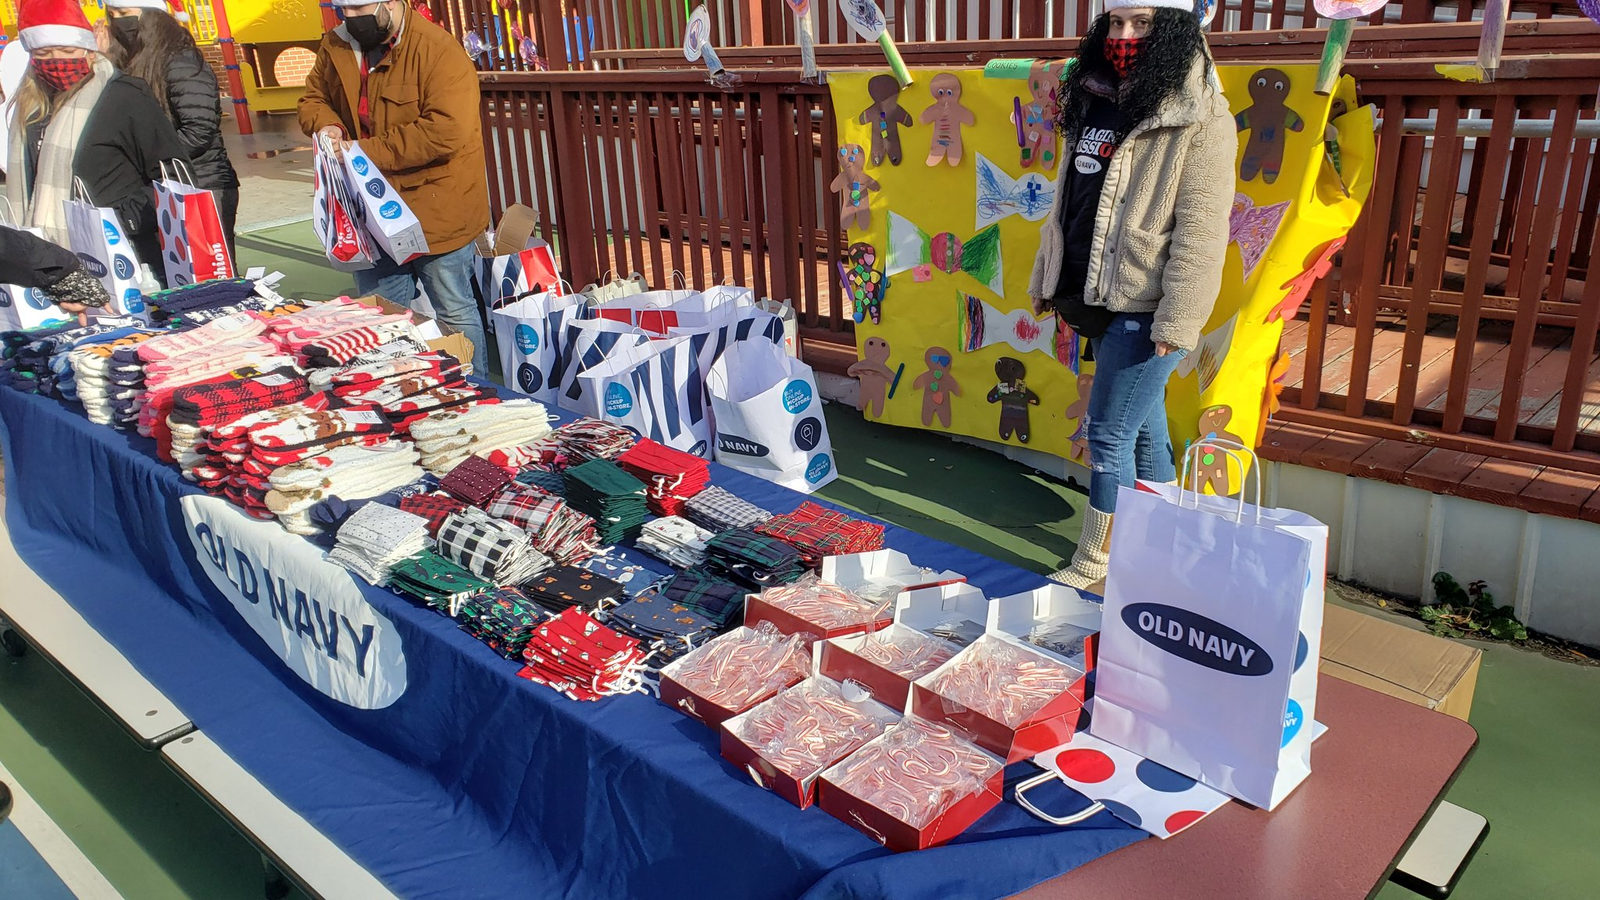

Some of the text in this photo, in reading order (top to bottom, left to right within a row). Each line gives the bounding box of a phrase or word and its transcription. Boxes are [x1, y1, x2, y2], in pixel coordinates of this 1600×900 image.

[211, 242, 228, 280] shion
[726, 440, 759, 455] NAVY
[195, 522, 375, 678] OLD NAVY
[1138, 611, 1255, 668] OLD NAVY
